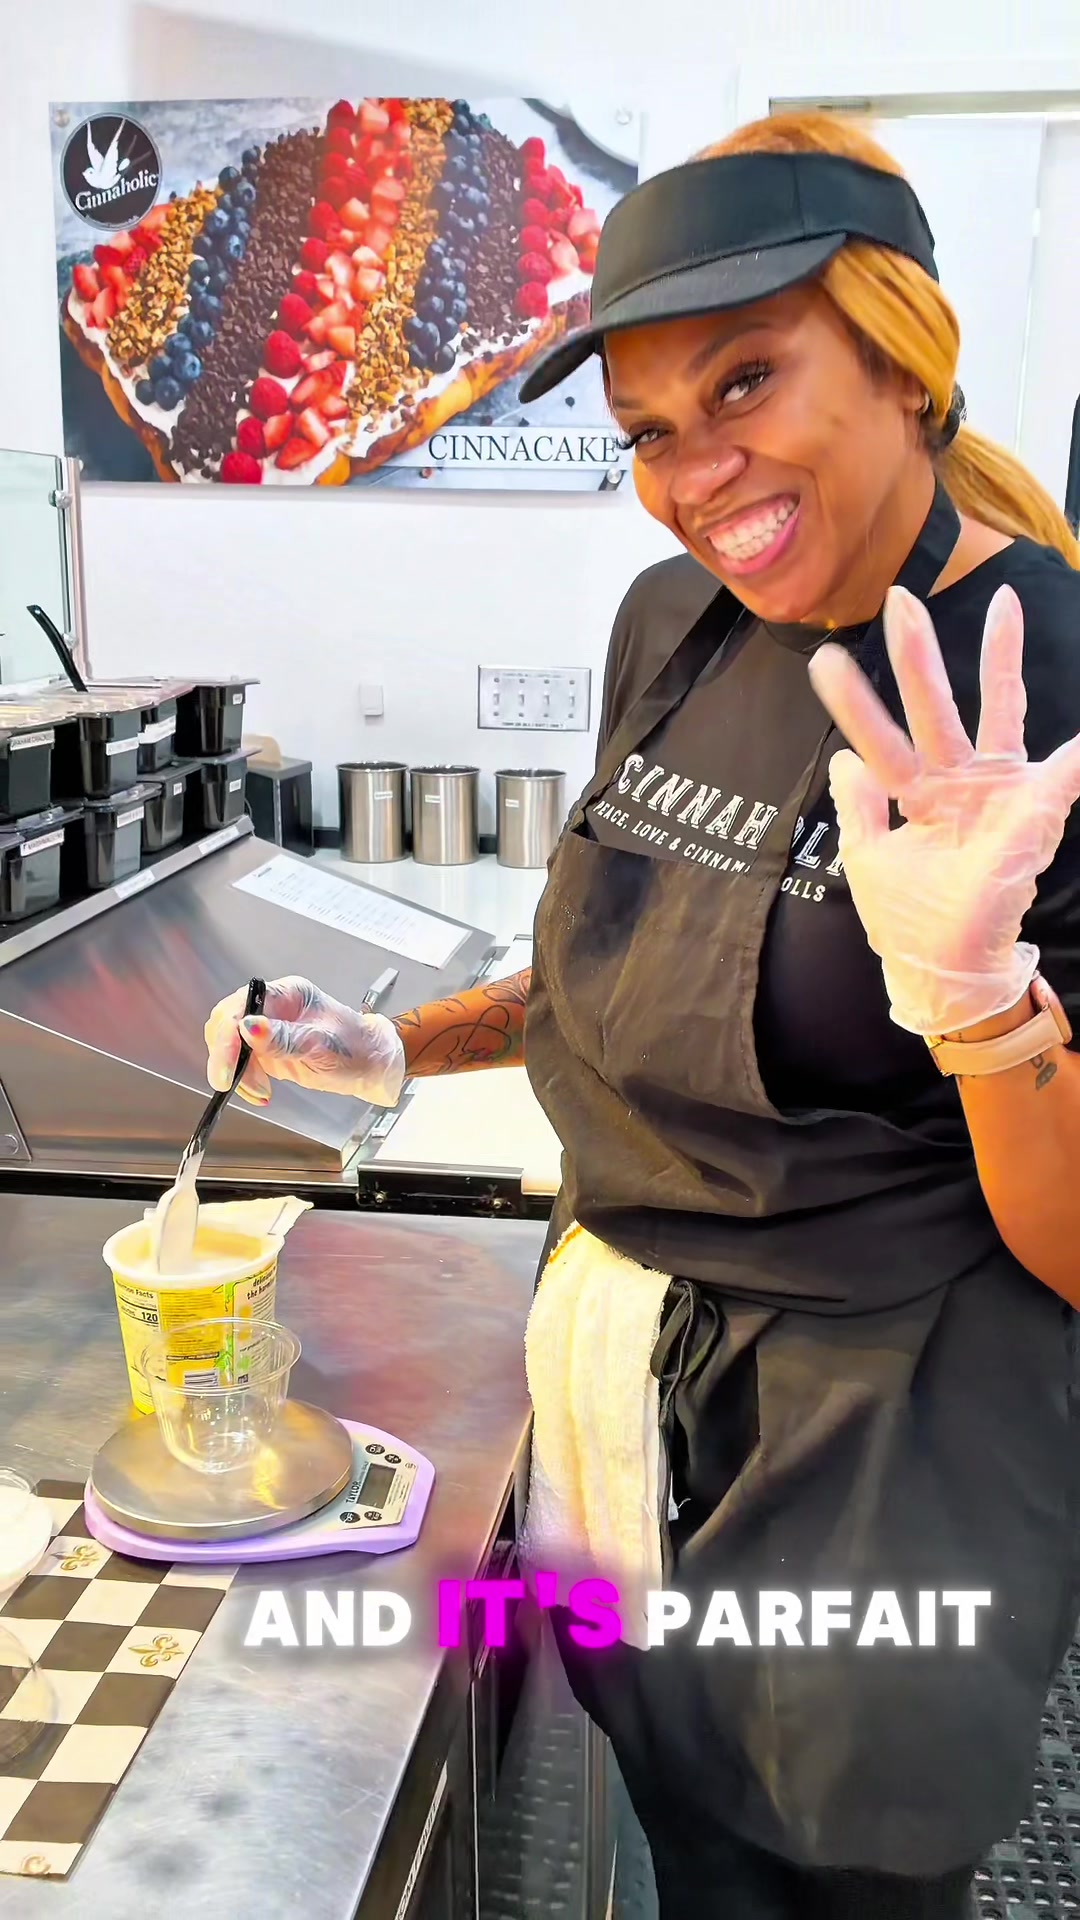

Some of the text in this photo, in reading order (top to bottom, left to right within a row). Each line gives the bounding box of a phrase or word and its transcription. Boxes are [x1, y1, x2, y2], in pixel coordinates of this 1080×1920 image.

[75, 169, 158, 210] Cinnaholic
[428, 434, 620, 463] CINNACAKE
[593, 800, 630, 829] PEACE,
[631, 820, 669, 845] LOVE
[668, 837, 681, 851] &
[781, 876, 826, 902] OLLS
[141, 1312, 158, 1322] 120
